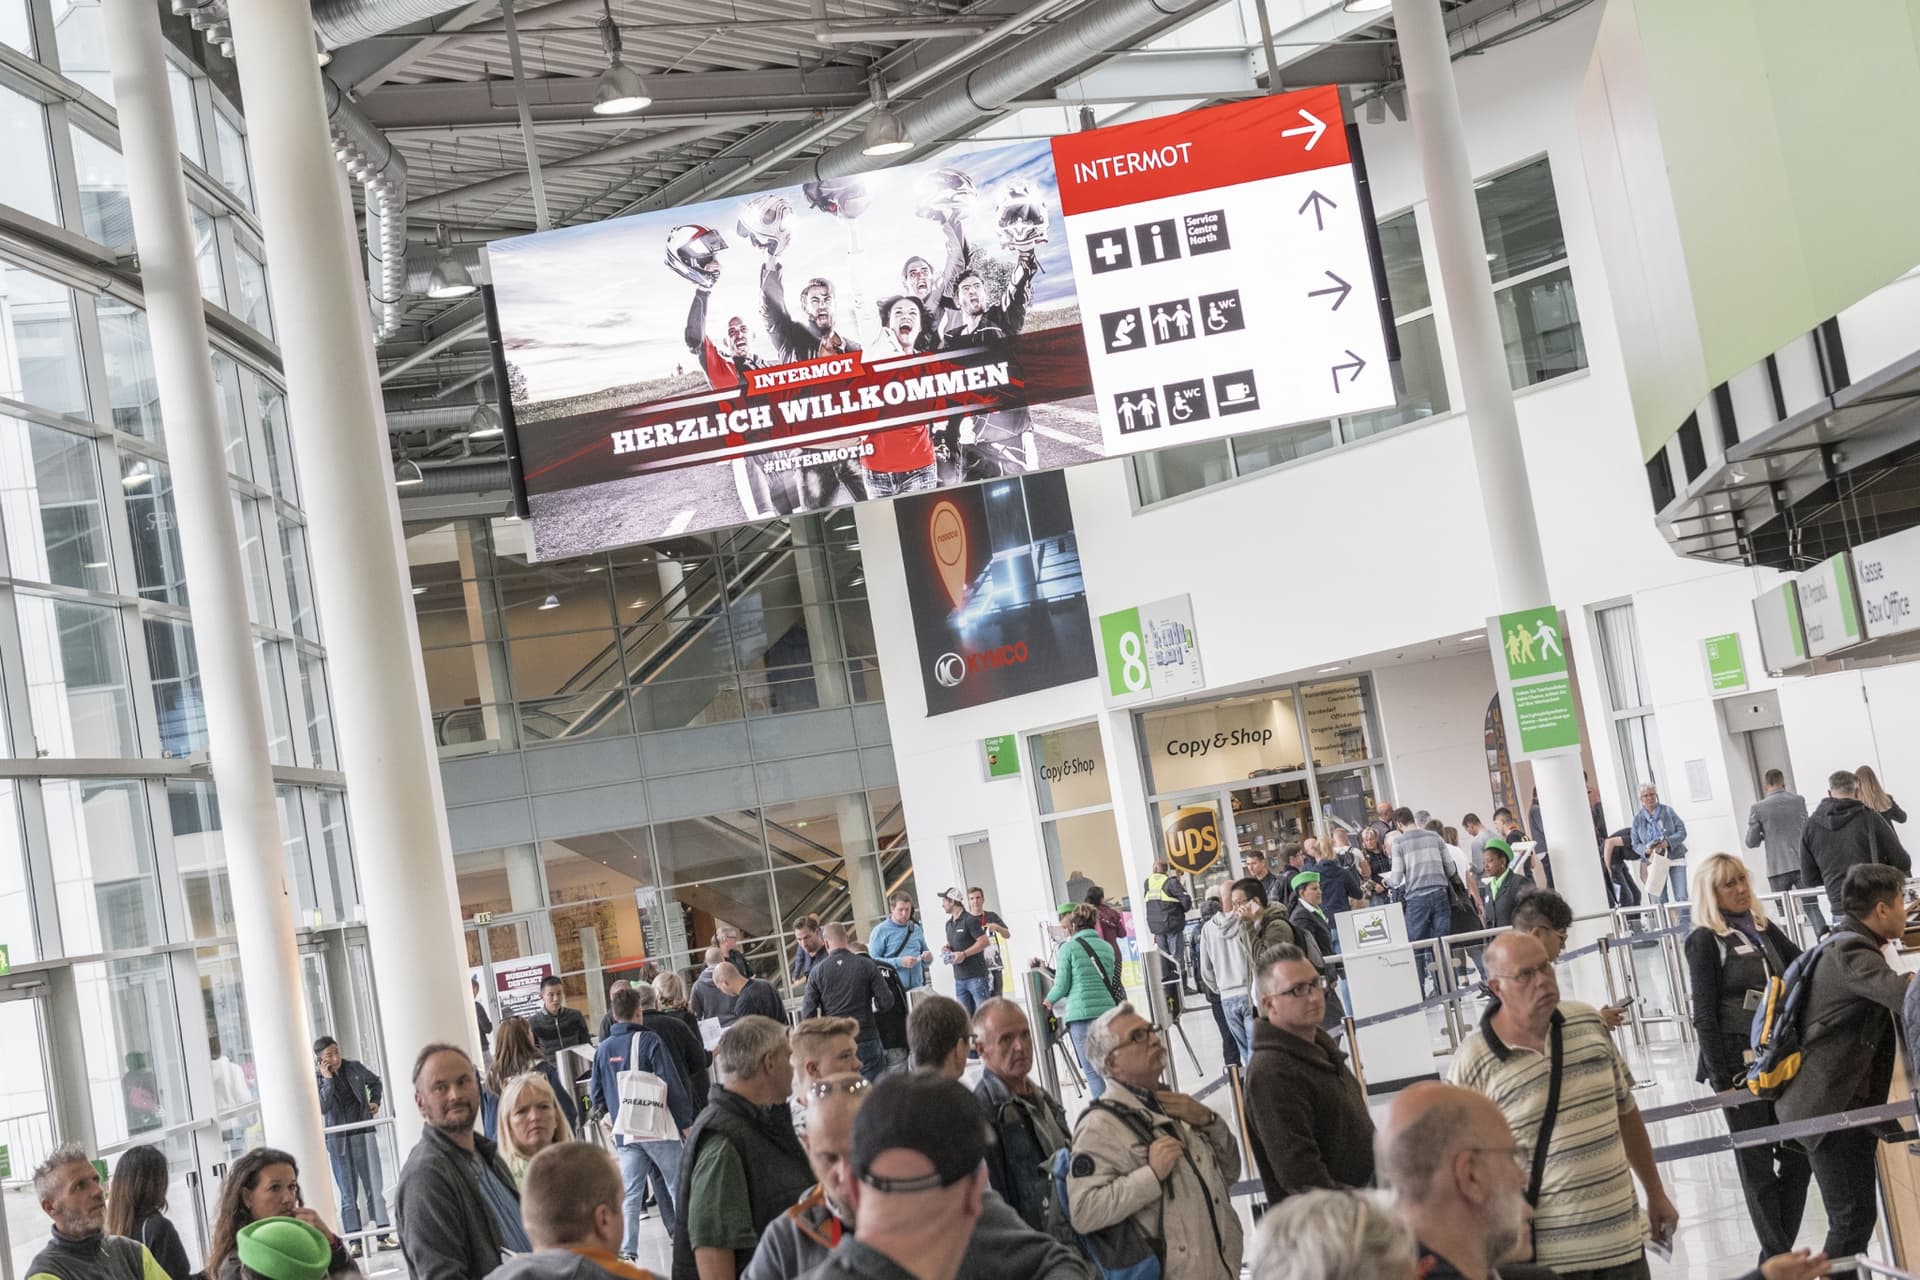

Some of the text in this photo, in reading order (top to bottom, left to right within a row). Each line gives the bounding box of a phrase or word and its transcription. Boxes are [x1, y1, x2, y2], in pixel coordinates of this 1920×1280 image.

[1073, 142, 1192, 184] INTERMOT
[1186, 214, 1218, 227] Service
[1188, 223, 1218, 236] Centre
[1190, 233, 1217, 246] North
[1218, 298, 1236, 310] WC
[753, 358, 853, 389] INTERMOT
[1183, 387, 1201, 399] WC
[611, 362, 1010, 455] HERZLICH WILLKOMMEN
[763, 443, 875, 474] #INTERMOT18
[1858, 560, 1884, 583] Kasse
[1867, 590, 1911, 626] Box Office
[966, 640, 1028, 673] KYMCO
[1119, 631, 1147, 692] 8
[1167, 737, 1210, 757] Copy
[1231, 728, 1273, 746] Shop
[1040, 763, 1062, 783] Copy
[1072, 757, 1095, 775] Shop
[1168, 825, 1218, 865] ups
[622, 1098, 664, 1109] PREALPINA
